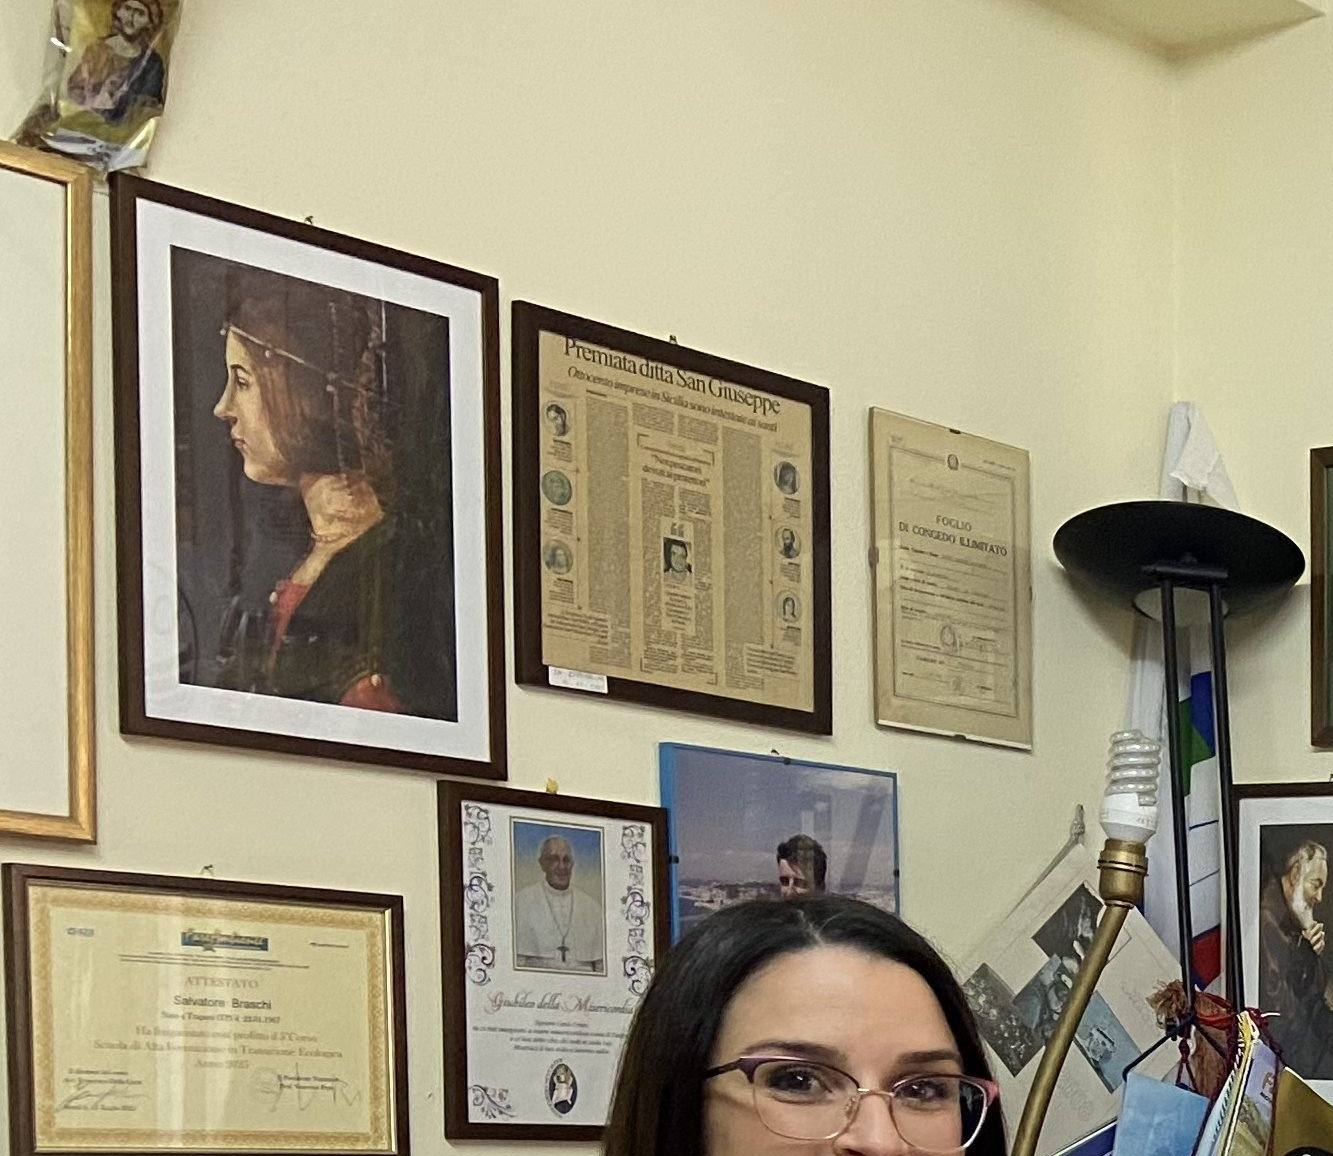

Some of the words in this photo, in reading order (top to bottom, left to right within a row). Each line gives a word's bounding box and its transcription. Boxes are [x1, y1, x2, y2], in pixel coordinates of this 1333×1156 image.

[563, 337, 637, 375] Premiata
[639, 358, 674, 385] ditta
[676, 368, 706, 394] San
[708, 379, 781, 416] Giuseppe
[936, 514, 973, 532] FOGLIO
[174, 995, 225, 1008] Salvatore
[231, 997, 272, 1011] Braschi
